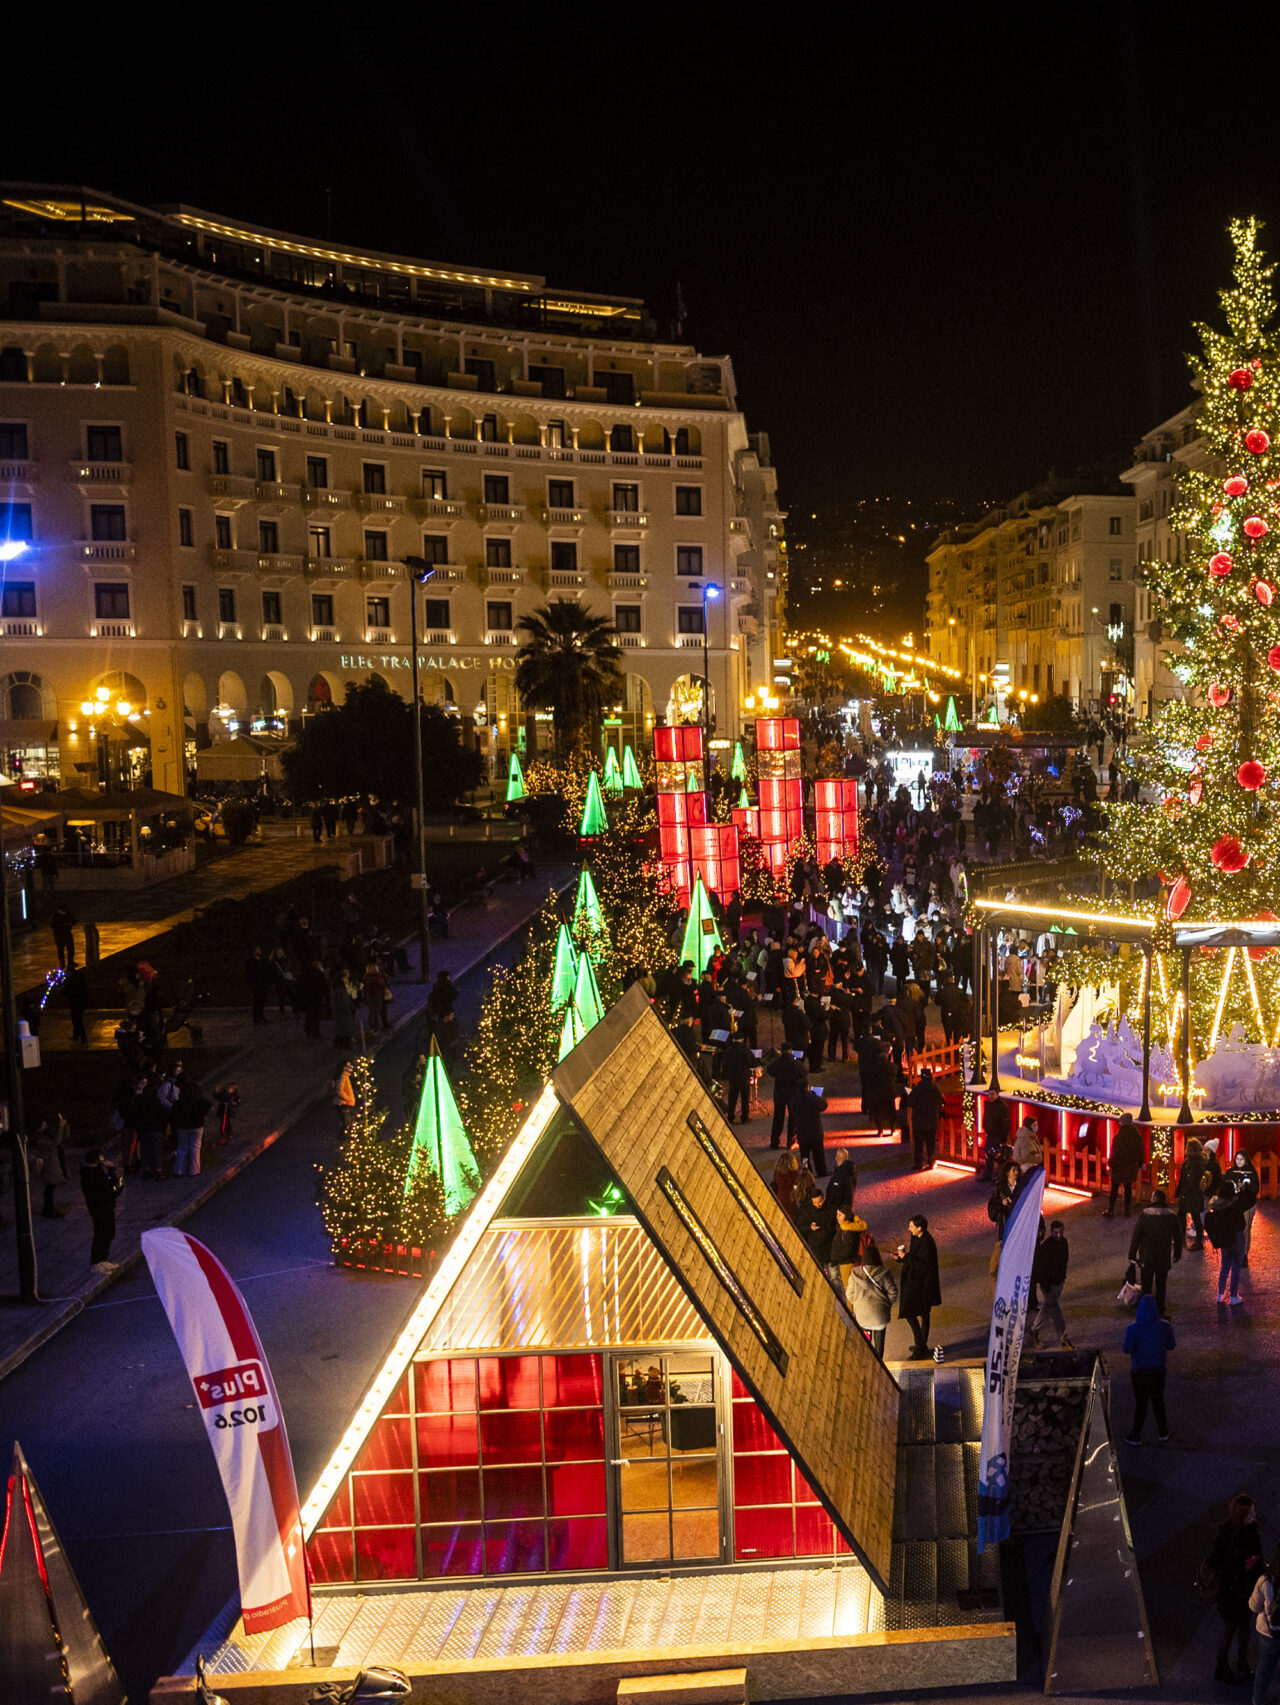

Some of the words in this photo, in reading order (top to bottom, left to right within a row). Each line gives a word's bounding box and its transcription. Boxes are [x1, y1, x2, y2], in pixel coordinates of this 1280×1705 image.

[340, 655, 411, 670] ELECTRA
[418, 655, 482, 671] PALACE
[1158, 1083, 1208, 1101] Αστρια
